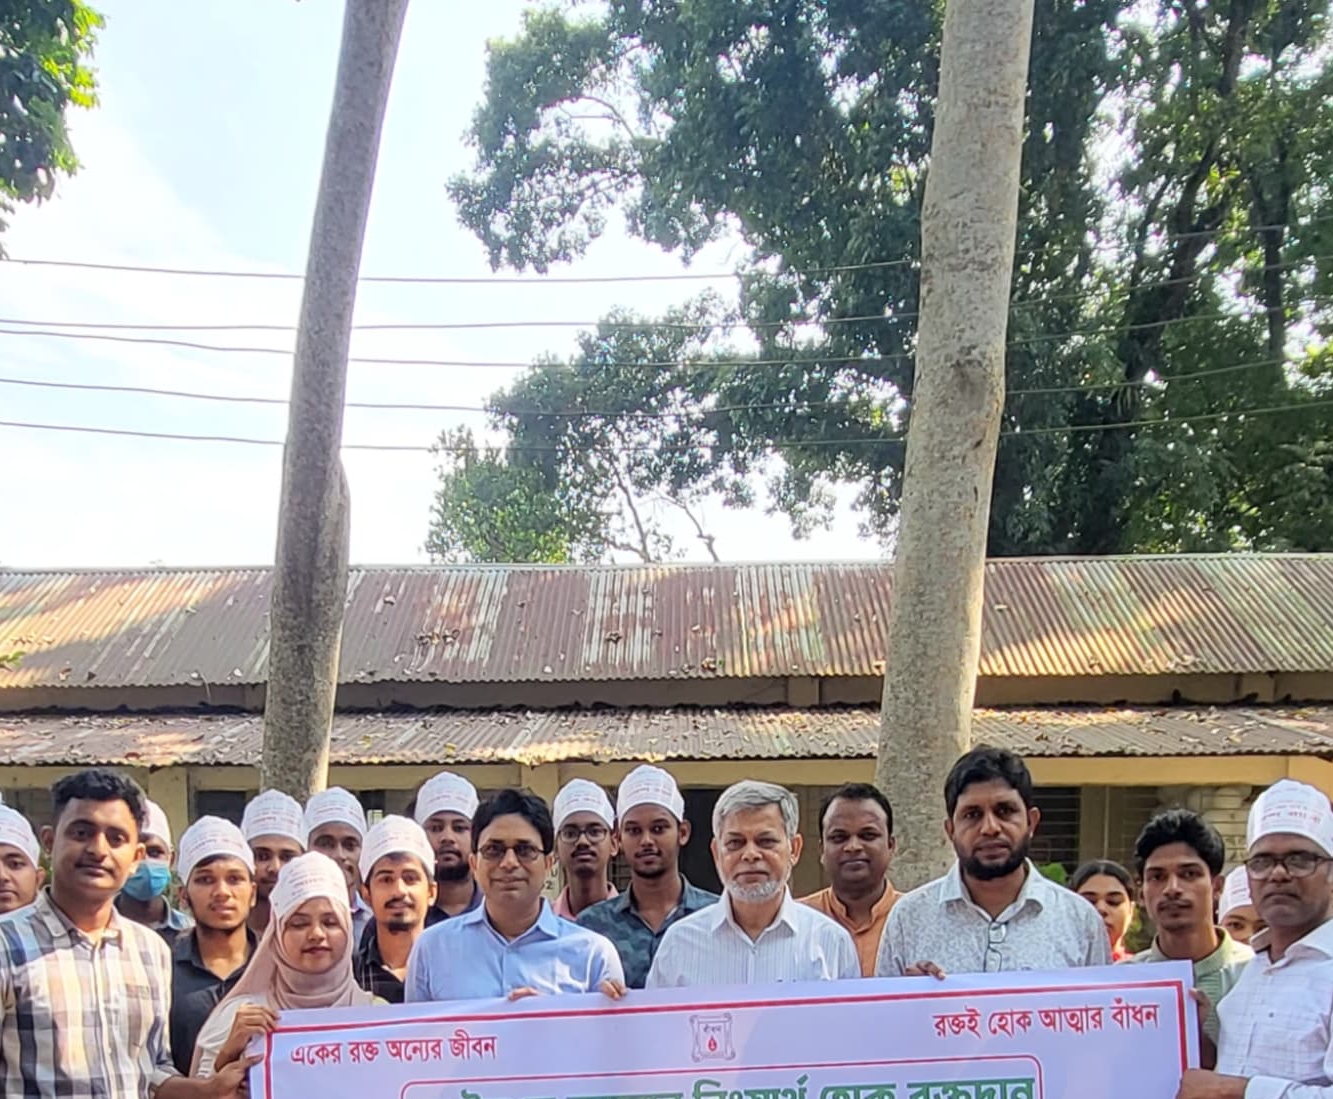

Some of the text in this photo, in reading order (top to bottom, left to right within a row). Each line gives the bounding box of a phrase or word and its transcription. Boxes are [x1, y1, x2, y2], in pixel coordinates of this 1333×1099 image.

[933, 998, 1159, 1038] রক্তই হোক আত্মার বাঁধন
[290, 1029, 497, 1065] একের রক্ত অন্যের জীবন
